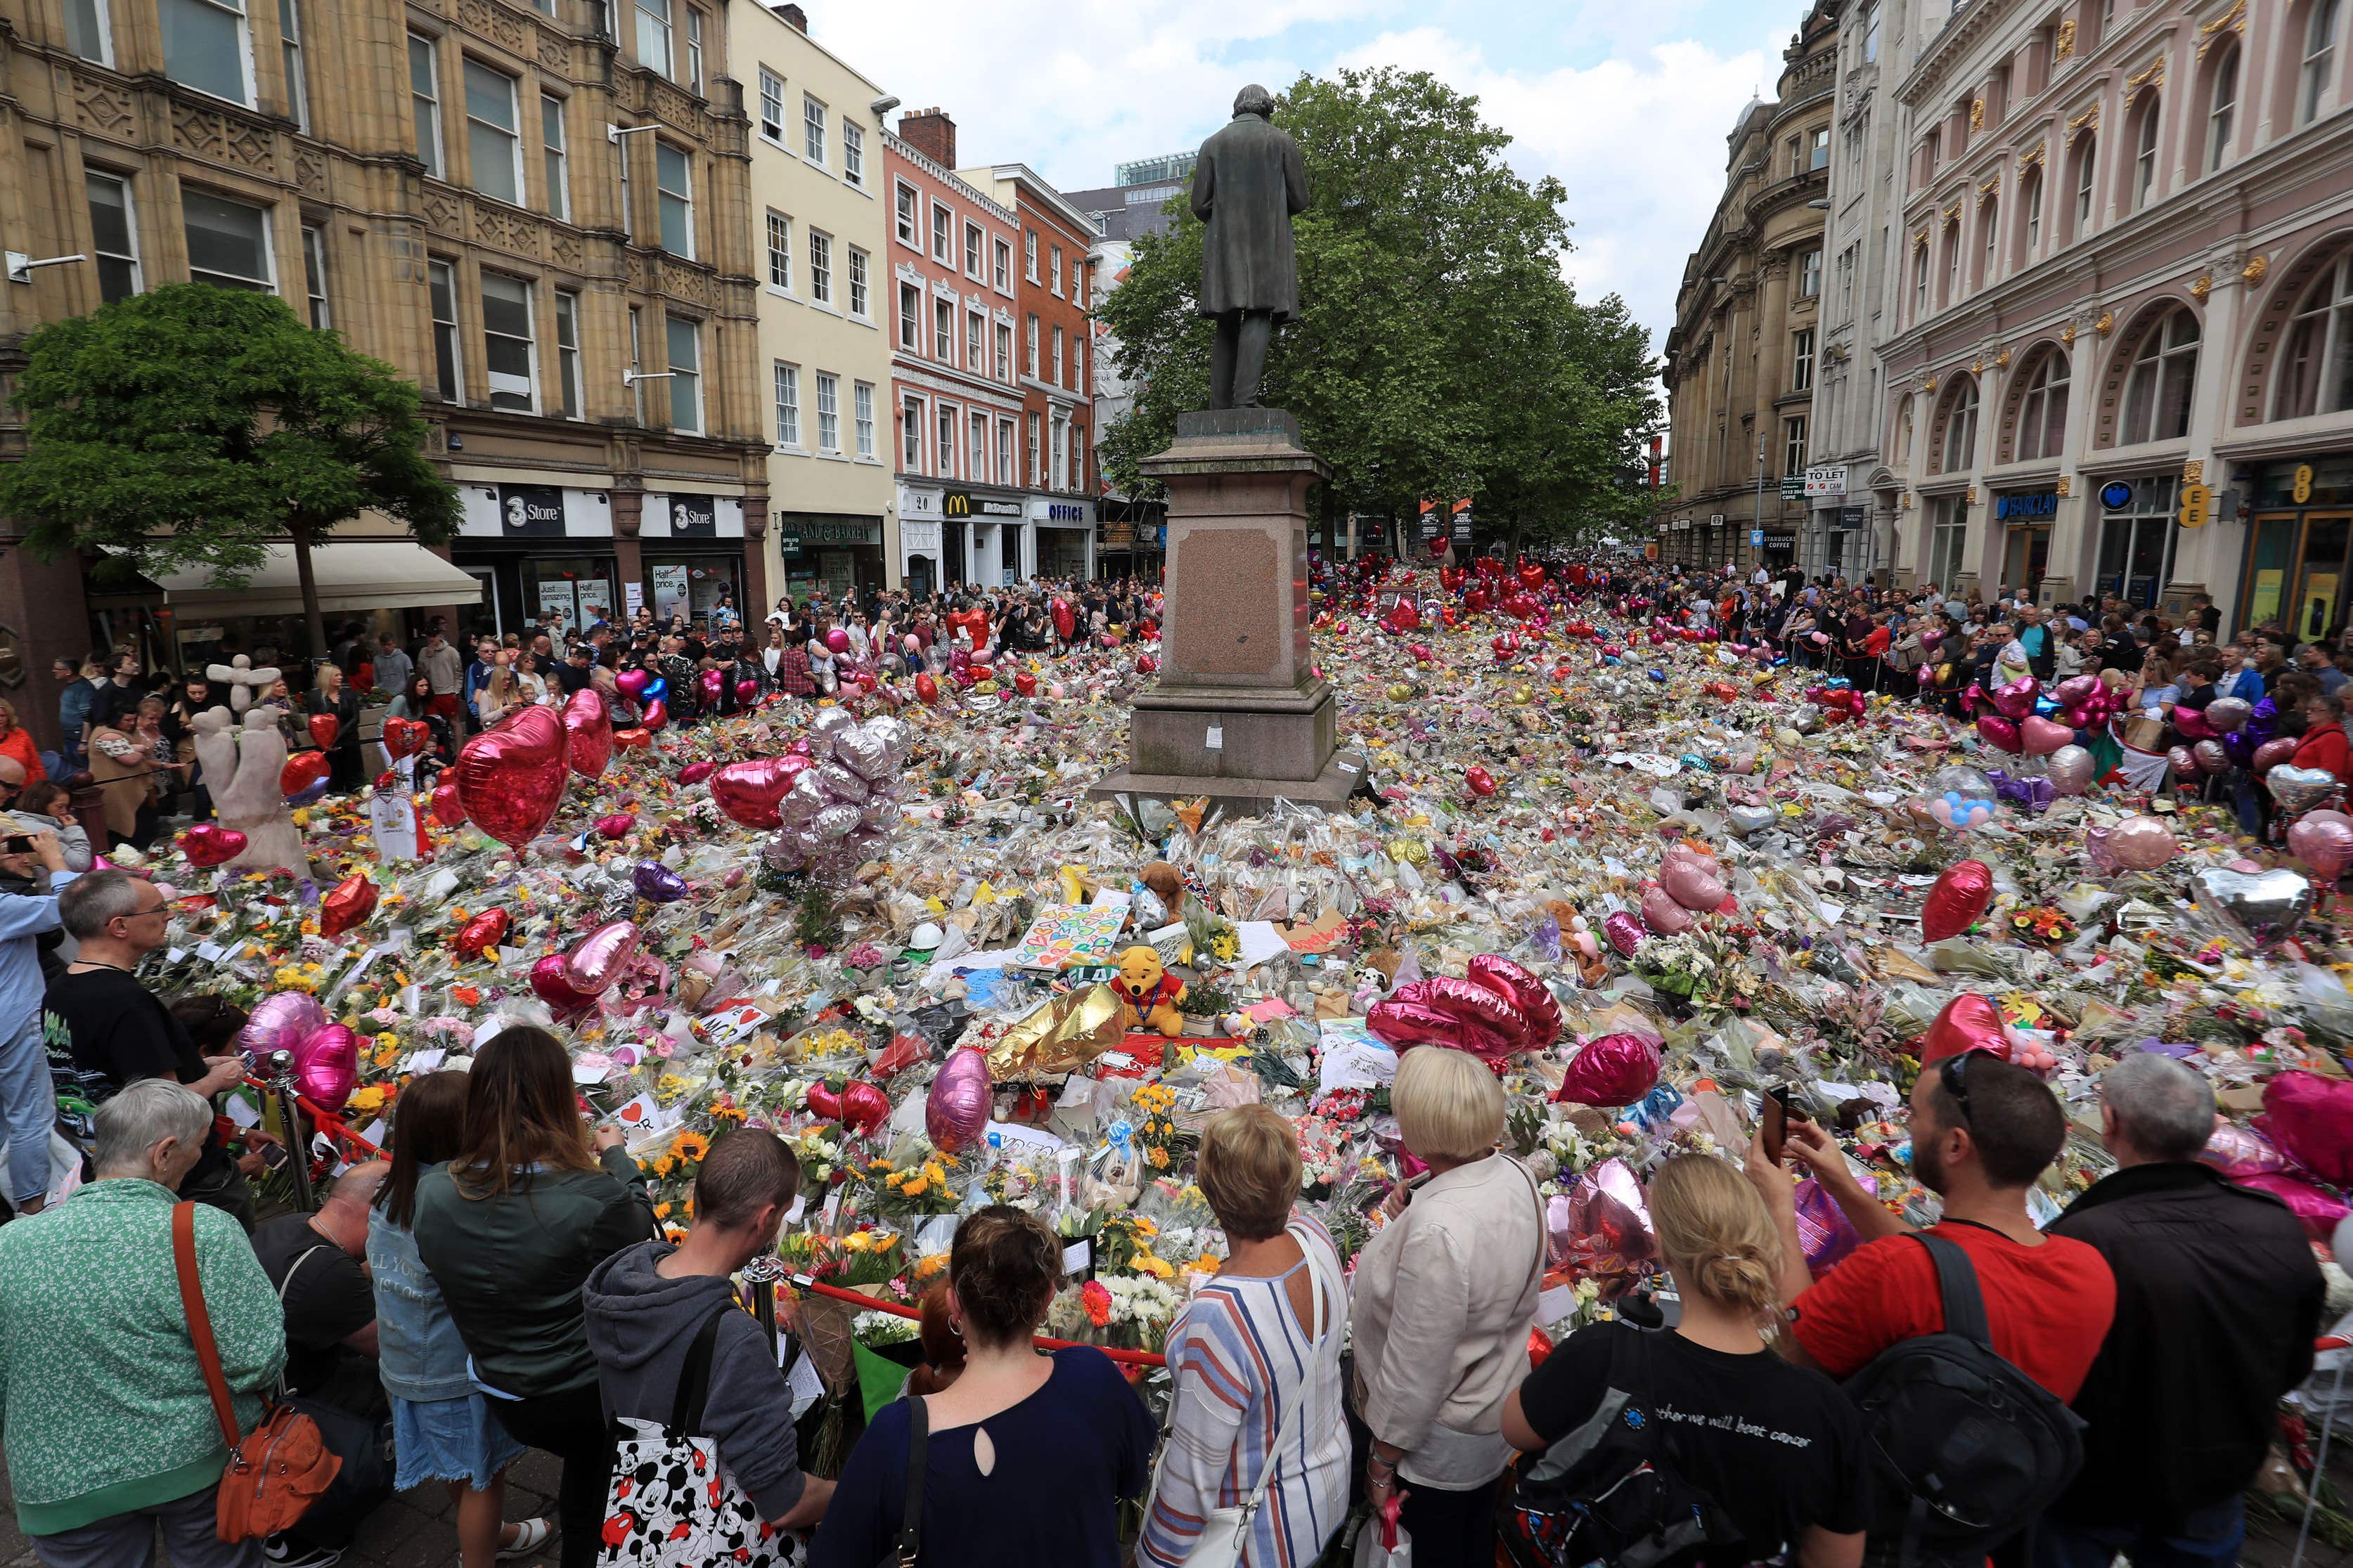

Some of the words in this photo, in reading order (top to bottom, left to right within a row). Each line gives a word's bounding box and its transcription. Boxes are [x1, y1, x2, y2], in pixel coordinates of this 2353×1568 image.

[507, 496, 527, 527] 3
[528, 504, 557, 520] Store
[674, 503, 689, 530] 3
[689, 510, 710, 524] Store
[1049, 504, 1083, 521] OFFICE
[783, 522, 821, 538] OAND
[823, 525, 831, 541] &
[835, 524, 871, 541] BARRETT
[655, 569, 669, 579] Half
[541, 585, 555, 593] Just
[579, 583, 592, 591] Half
[655, 580, 675, 590] price.
[541, 593, 572, 602] amazing.
[580, 591, 598, 600] price.
[1154, 992, 1168, 1000] ooh
[1350, 1062, 1370, 1075] STAND
[1687, 1413, 1706, 1426] we
[1708, 1415, 1733, 1430] will
[1734, 1415, 1768, 1438] beat
[1769, 1430, 1812, 1448] cancer
